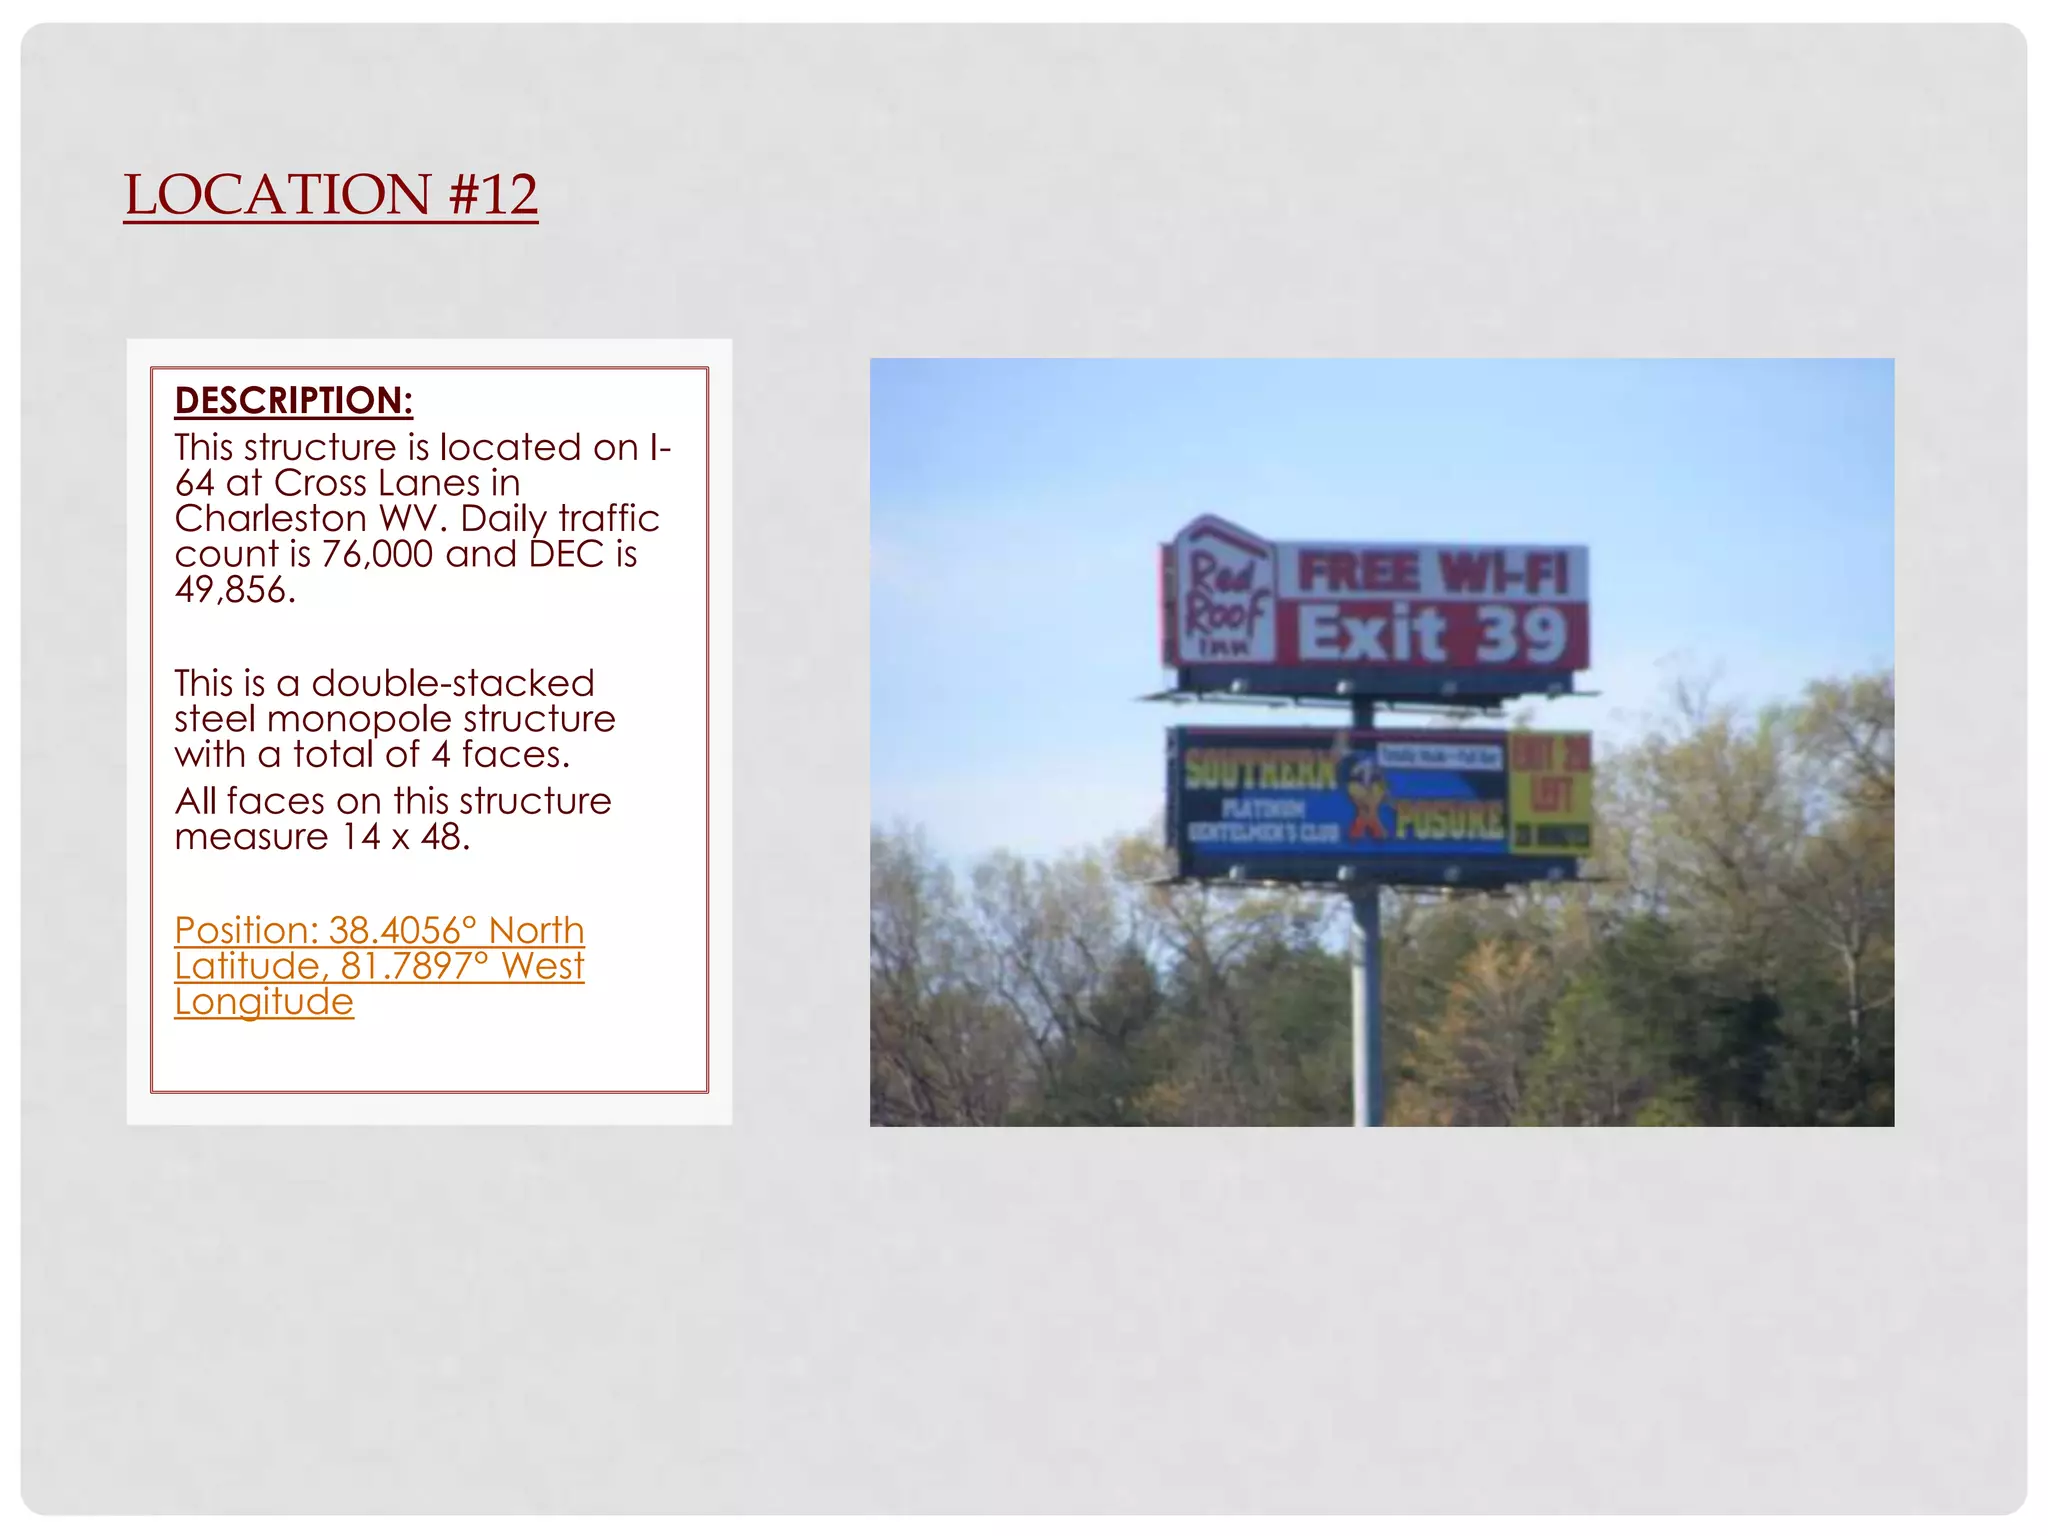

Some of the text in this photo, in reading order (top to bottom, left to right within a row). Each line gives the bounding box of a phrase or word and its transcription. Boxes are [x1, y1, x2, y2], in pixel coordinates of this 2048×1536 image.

[1189, 551, 1255, 594] Red
[1299, 551, 1420, 592] FREE
[1187, 590, 1270, 637] Roof
[1300, 603, 1568, 663] Exit 39
[1186, 748, 1340, 789] SOUTHERN
